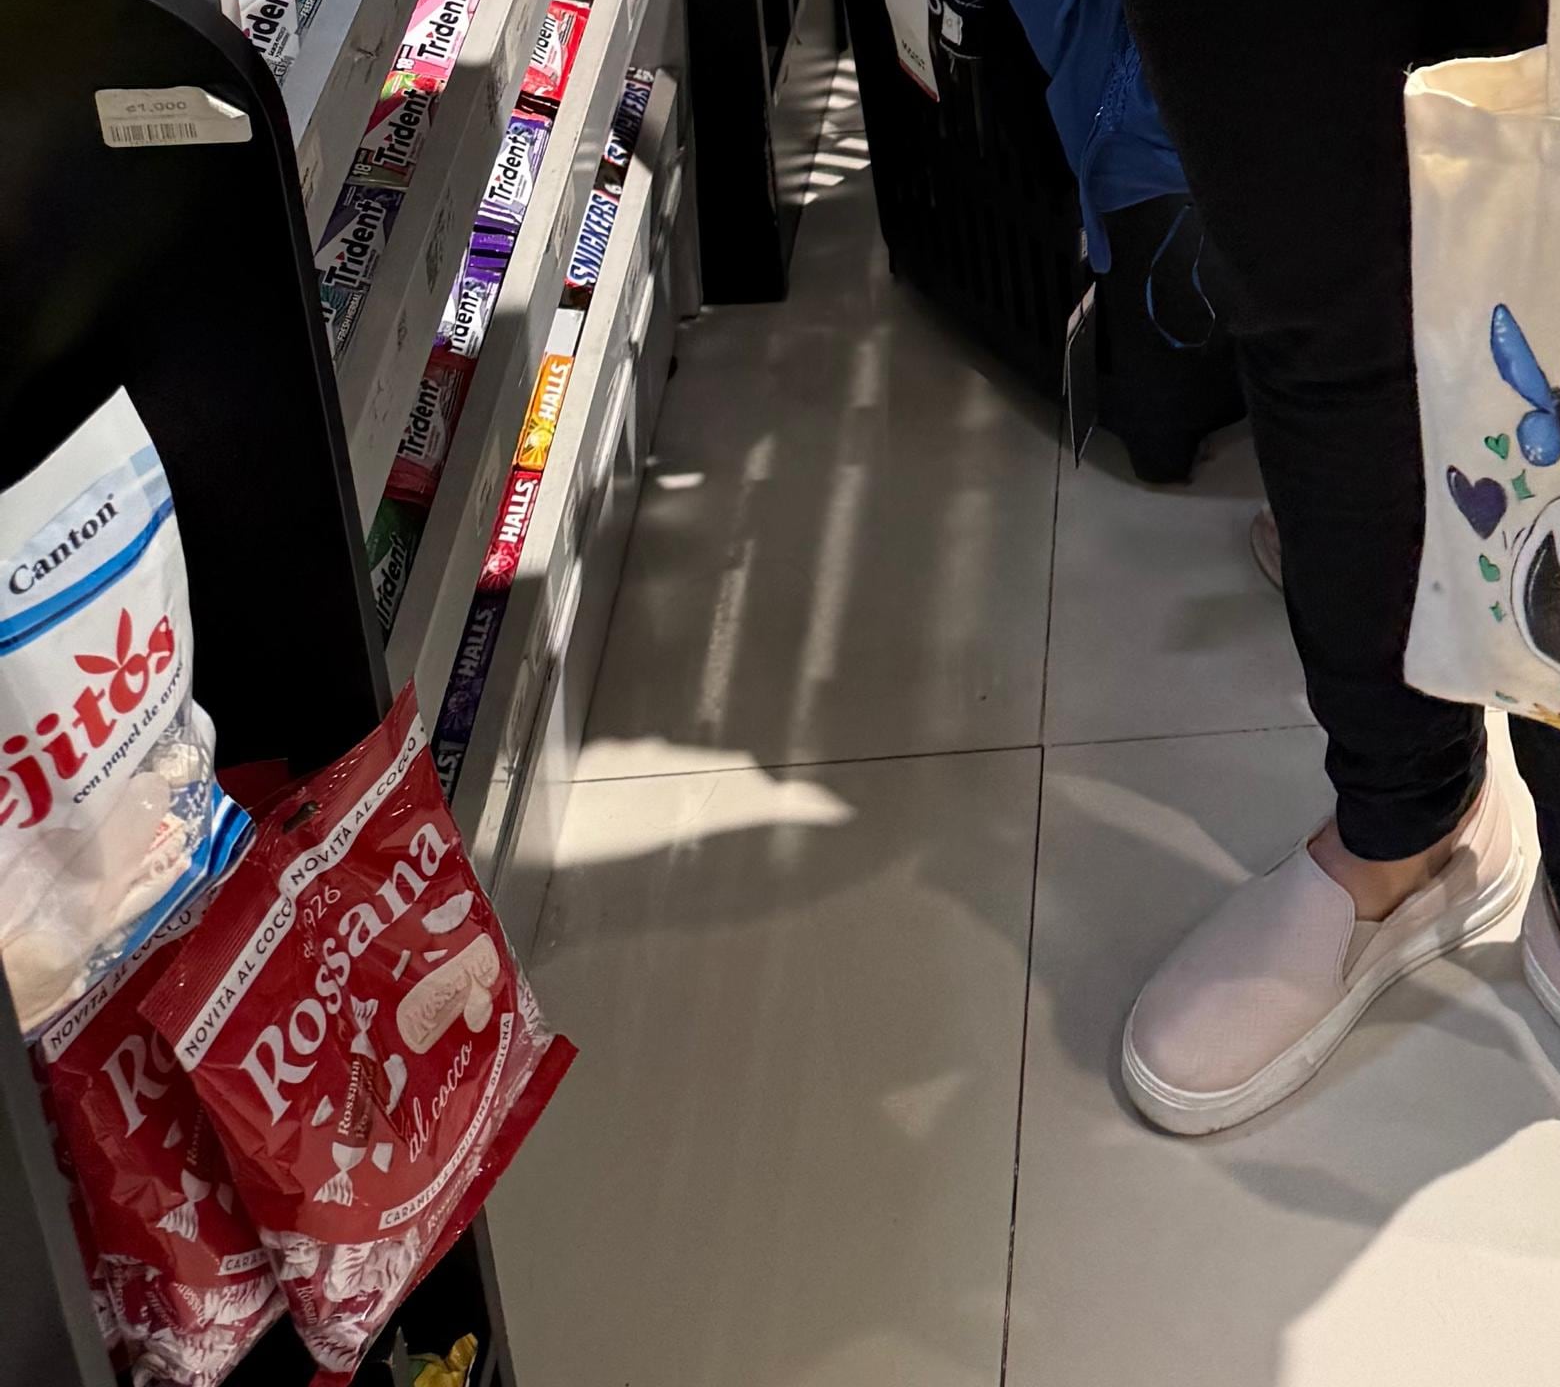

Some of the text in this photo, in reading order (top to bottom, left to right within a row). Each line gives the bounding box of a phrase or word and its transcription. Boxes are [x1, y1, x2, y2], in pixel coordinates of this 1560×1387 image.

[373, 88, 429, 167] Trident
[352, 162, 372, 179] 18
[489, 133, 528, 201] Trident
[323, 198, 385, 286] Trident
[569, 195, 617, 284] SNICKERS
[449, 289, 480, 353] rident
[398, 379, 440, 457] Trident
[539, 362, 571, 421] HALLS
[8, 494, 119, 596] Canton
[499, 478, 538, 543] HALLS
[462, 608, 497, 677] HALLS
[73, 774, 101, 805] con
[102, 725, 142, 776] papel
[142, 703, 160, 730] de
[290, 735, 418, 888] NOVITÀ AL COCCO
[183, 984, 237, 1058] NOVITÀ
[237, 958, 256, 986] AL
[240, 819, 452, 1127] Rossana
[50, 989, 109, 1049] NOVITÀ
[337, 1060, 361, 1136] Rossana
[431, 1040, 474, 1126] cocco
